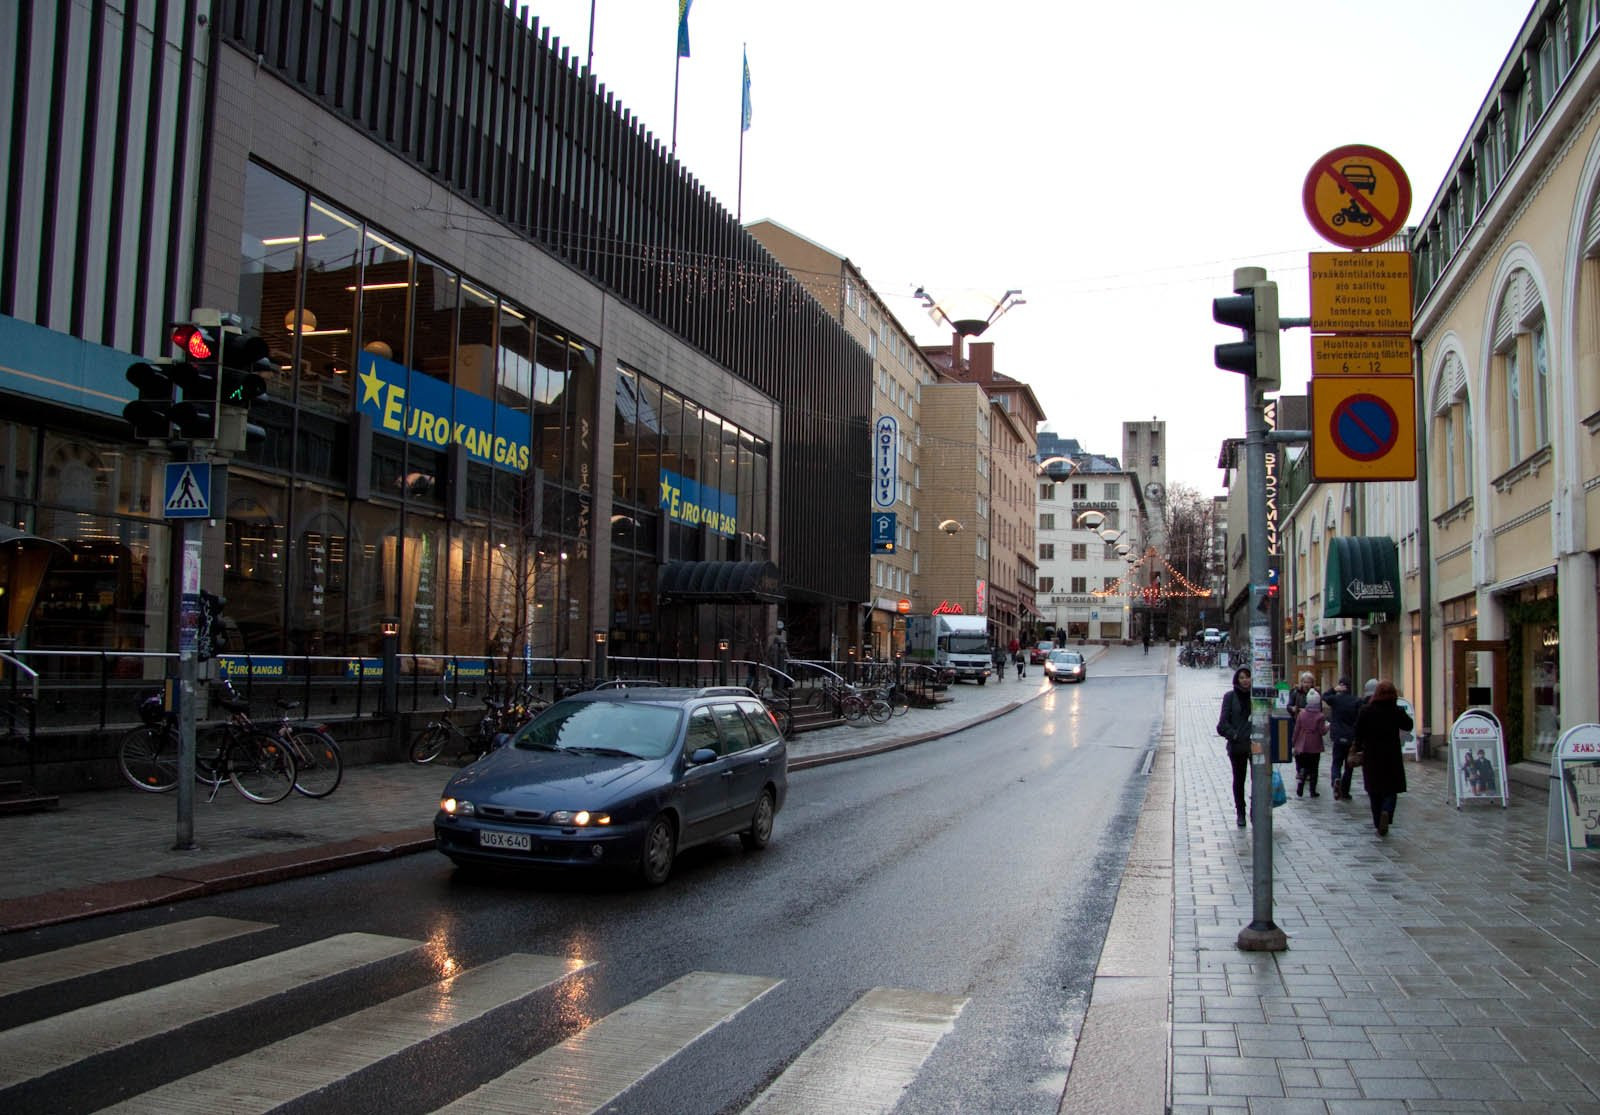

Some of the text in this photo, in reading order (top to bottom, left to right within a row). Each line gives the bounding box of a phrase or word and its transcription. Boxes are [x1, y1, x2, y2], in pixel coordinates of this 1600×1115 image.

[1342, 362, 1349, 373] 6
[1368, 361, 1382, 372] 12
[881, 423, 892, 500] MOTIVUS
[1072, 501, 1118, 509] SCANDIC
[879, 520, 889, 533] P
[483, 832, 529, 848] UGX-640
